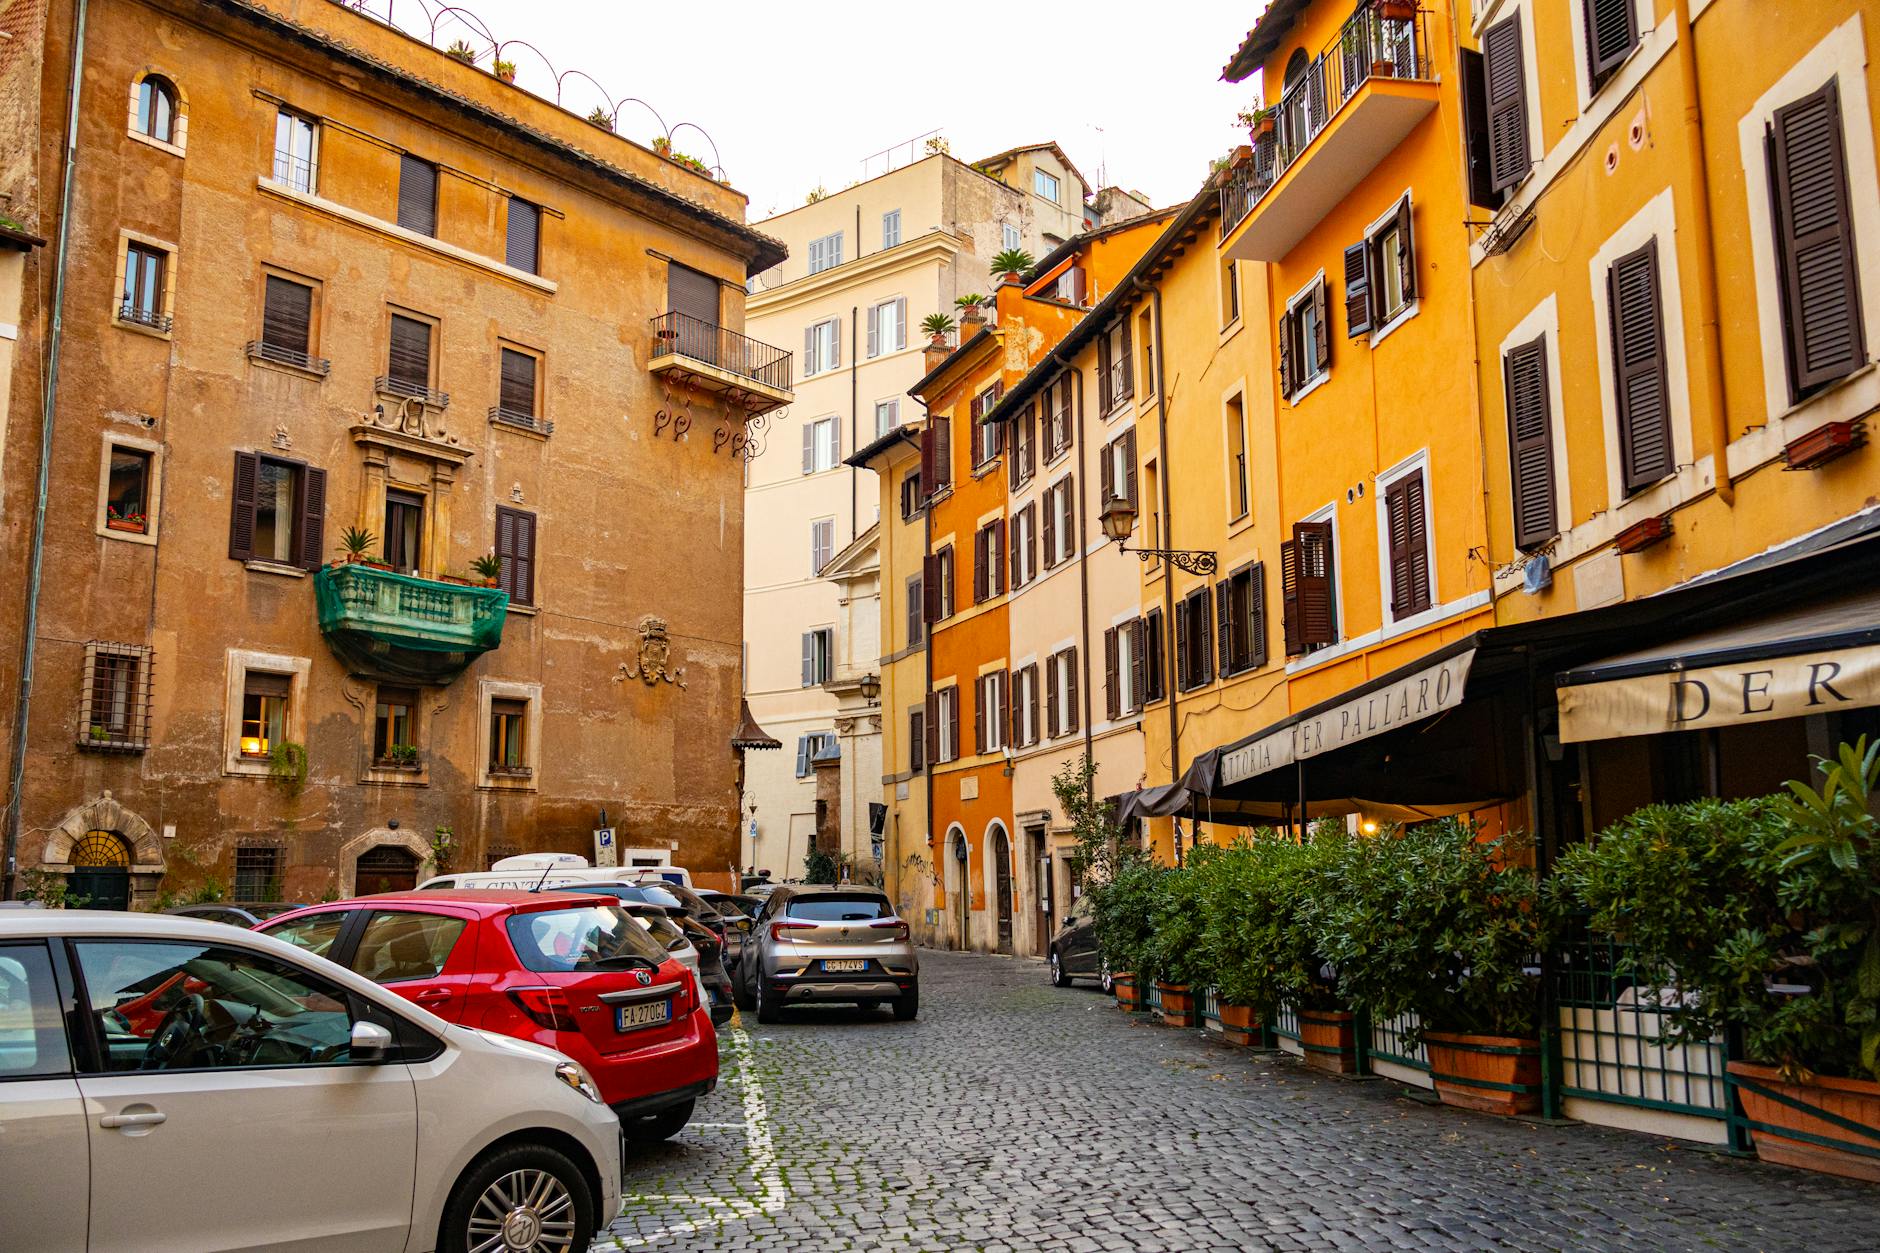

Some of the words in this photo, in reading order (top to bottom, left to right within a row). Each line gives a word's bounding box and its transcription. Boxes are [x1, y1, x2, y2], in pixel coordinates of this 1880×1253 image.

[1340, 668, 1451, 741] PALLARO
[1669, 661, 1854, 724] DER
[601, 831, 609, 845] P
[623, 1007, 635, 1026] FA
[639, 1002, 667, 1023] 270GZ
